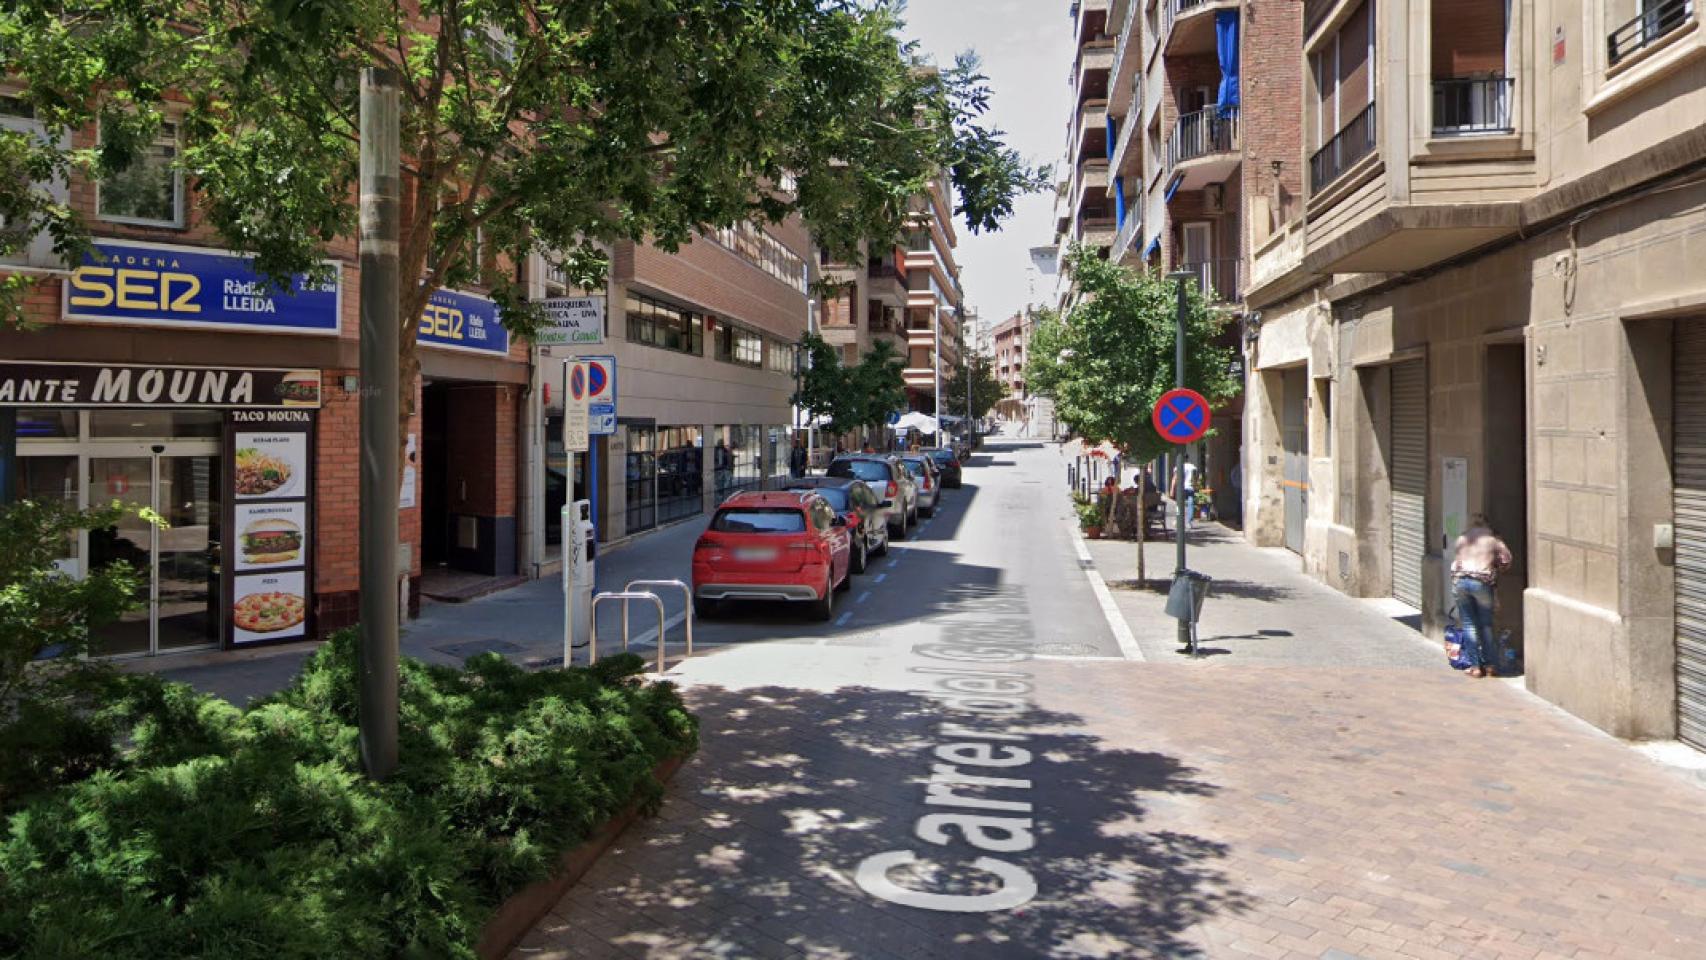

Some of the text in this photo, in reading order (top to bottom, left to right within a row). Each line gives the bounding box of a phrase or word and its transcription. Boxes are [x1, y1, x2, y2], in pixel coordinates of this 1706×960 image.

[98, 254, 180, 268] ADENA
[70, 266, 201, 312] SER
[223, 295, 276, 313] LLEIDA
[541, 300, 593, 309] ERRUQUERIA
[581, 309, 598, 318] UVA
[418, 304, 464, 339] SER
[556, 319, 580, 327] AUNA
[0, 368, 254, 403] ANTE MOUNA
[233, 411, 310, 422] TACO MOUNA
